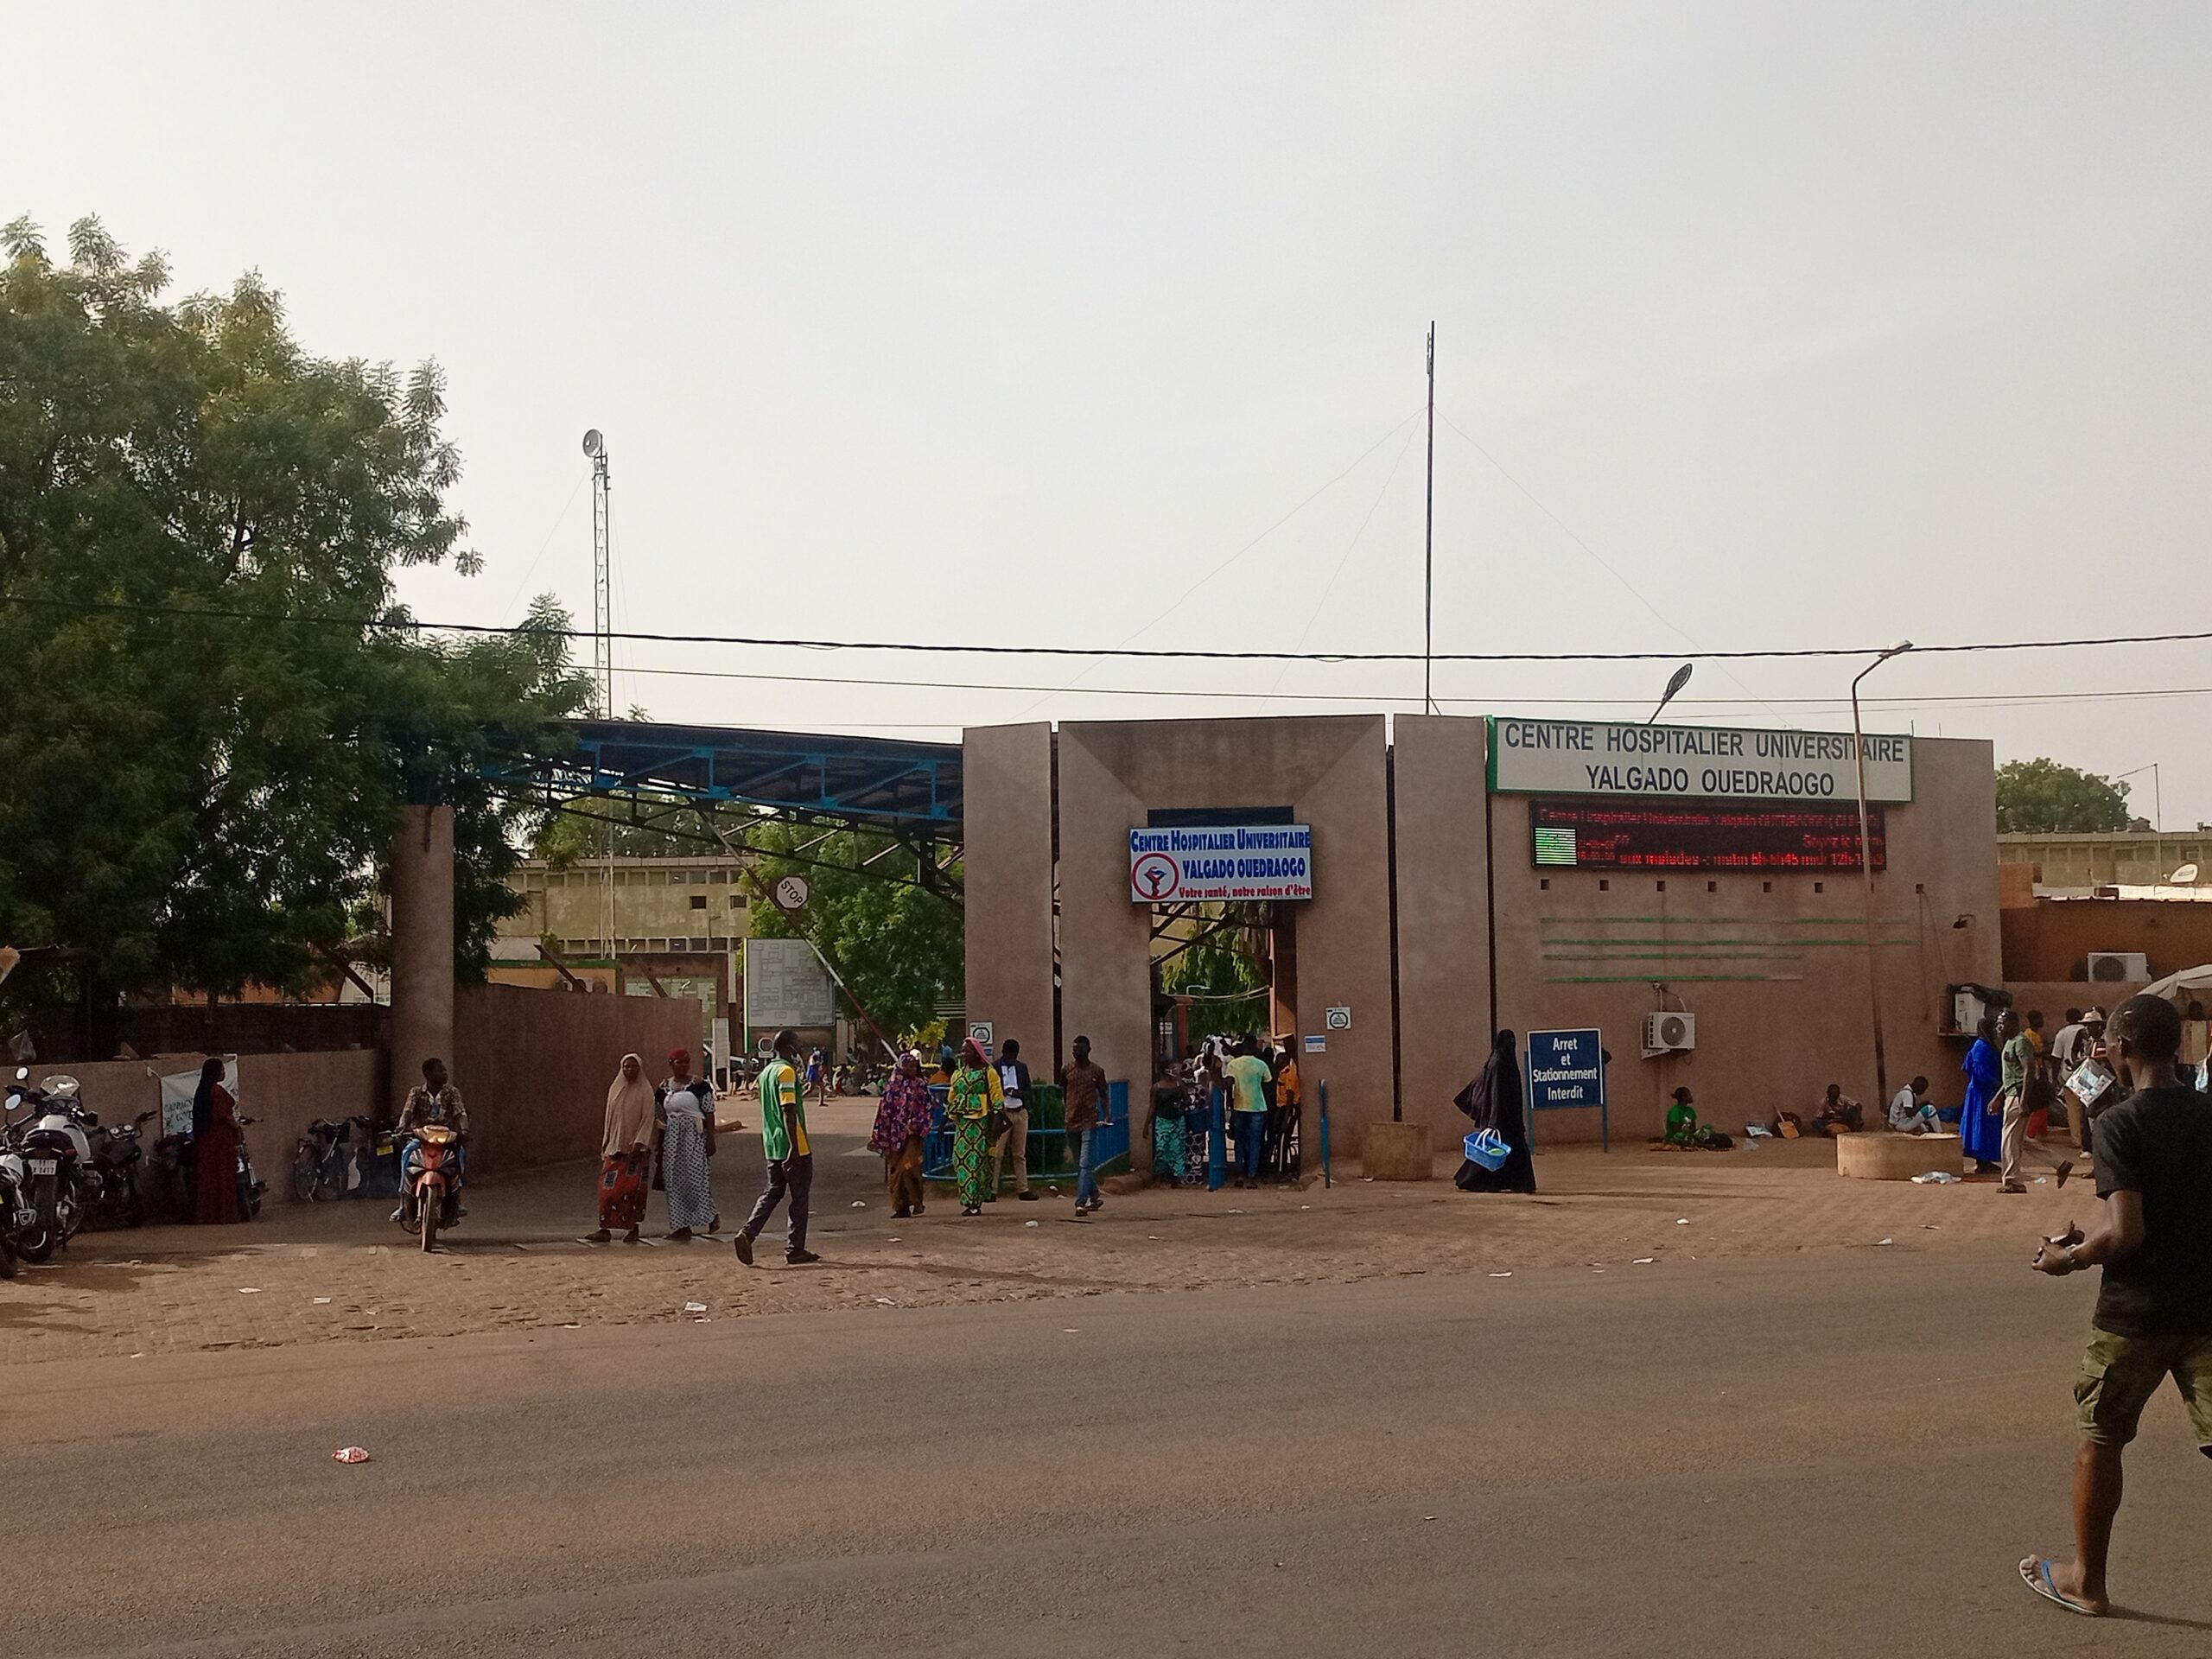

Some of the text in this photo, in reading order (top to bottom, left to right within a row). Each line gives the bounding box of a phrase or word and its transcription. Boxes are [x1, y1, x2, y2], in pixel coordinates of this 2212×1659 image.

[1505, 721, 1904, 762] CENTRE HOSPITALIER UNIVERSITAIRE
[1586, 764, 1835, 797] YALGADO OUEDRAOGO
[1130, 829, 1311, 852] CENTRE HOSPITALIER UNIVERSITAIRE
[1182, 857, 1306, 880] YALGADO OUEDRAOGO
[780, 880, 804, 904] STOP
[1179, 884, 1311, 899] Votre santé, notre raison d'être
[1553, 1038, 1578, 1051] Arret
[1560, 1053, 1571, 1065] et
[1533, 1067, 1598, 1083] Stationnement
[1548, 1085, 1584, 1101] Interdit
